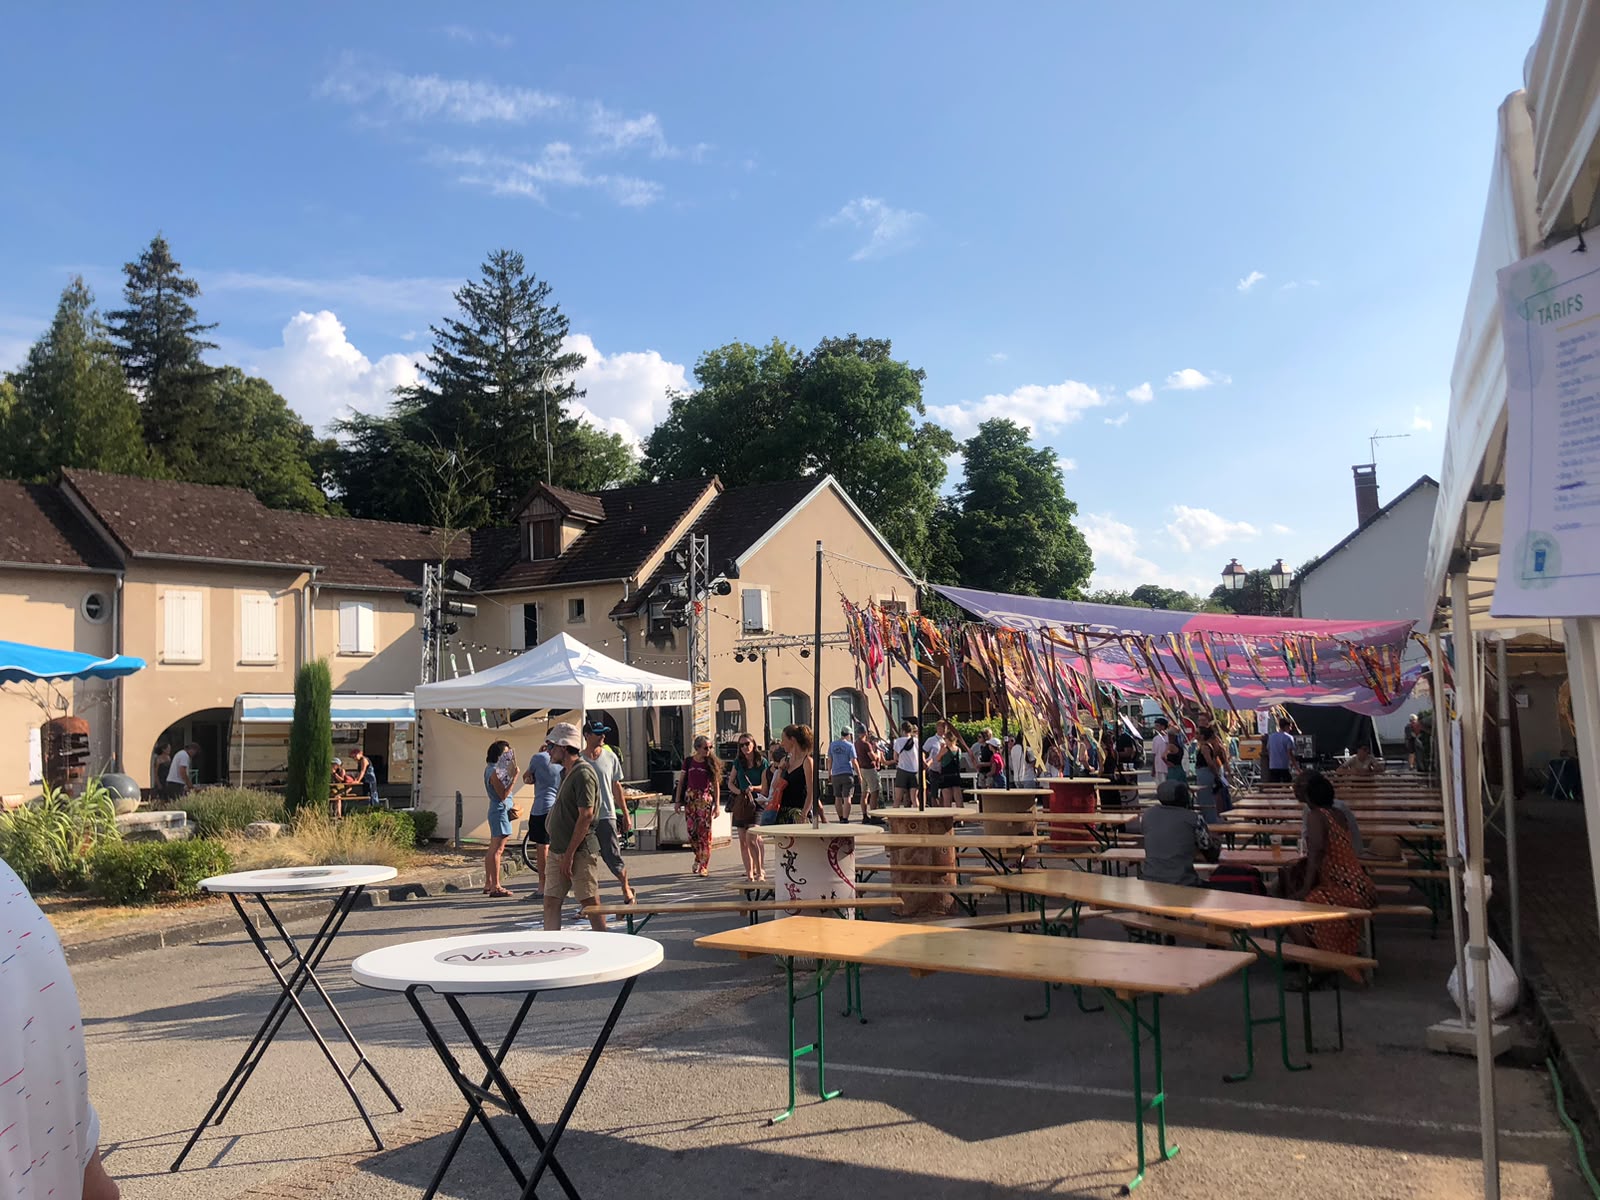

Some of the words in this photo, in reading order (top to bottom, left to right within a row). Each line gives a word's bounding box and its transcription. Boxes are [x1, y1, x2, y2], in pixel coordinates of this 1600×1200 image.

[1537, 293, 1583, 326] TARIFS
[597, 692, 620, 703] COMITE
[660, 690, 668, 700] DE
